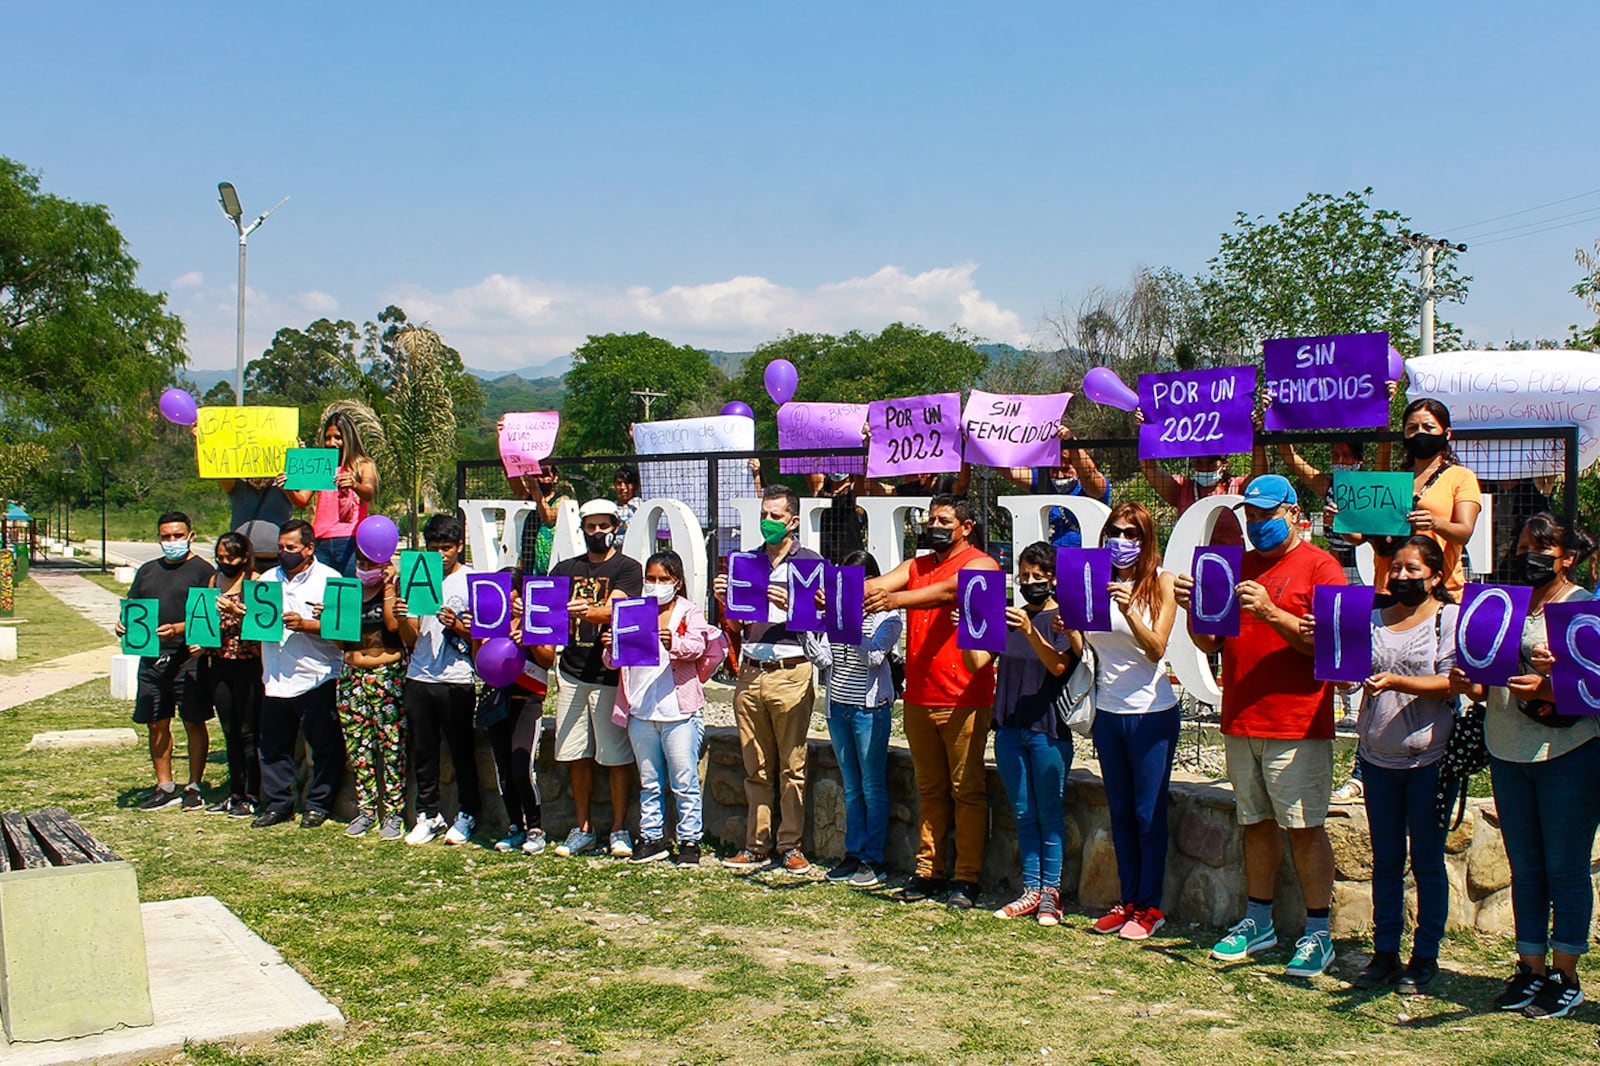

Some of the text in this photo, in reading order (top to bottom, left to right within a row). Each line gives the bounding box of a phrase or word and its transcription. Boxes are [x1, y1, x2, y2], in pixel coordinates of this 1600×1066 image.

[1296, 341, 1335, 369] SIN
[1153, 376, 1236, 409] POR UN
[1266, 374, 1375, 404] FEMICIDIOS
[1413, 371, 1520, 394] POLITICAS
[886, 404, 942, 430] POR UN
[990, 401, 1022, 417] SIN
[1468, 403, 1504, 422] NOS
[1509, 401, 1599, 423] GARANTICE
[235, 430, 258, 448] DE
[1160, 411, 1224, 442] 2022
[887, 430, 944, 464] 2022
